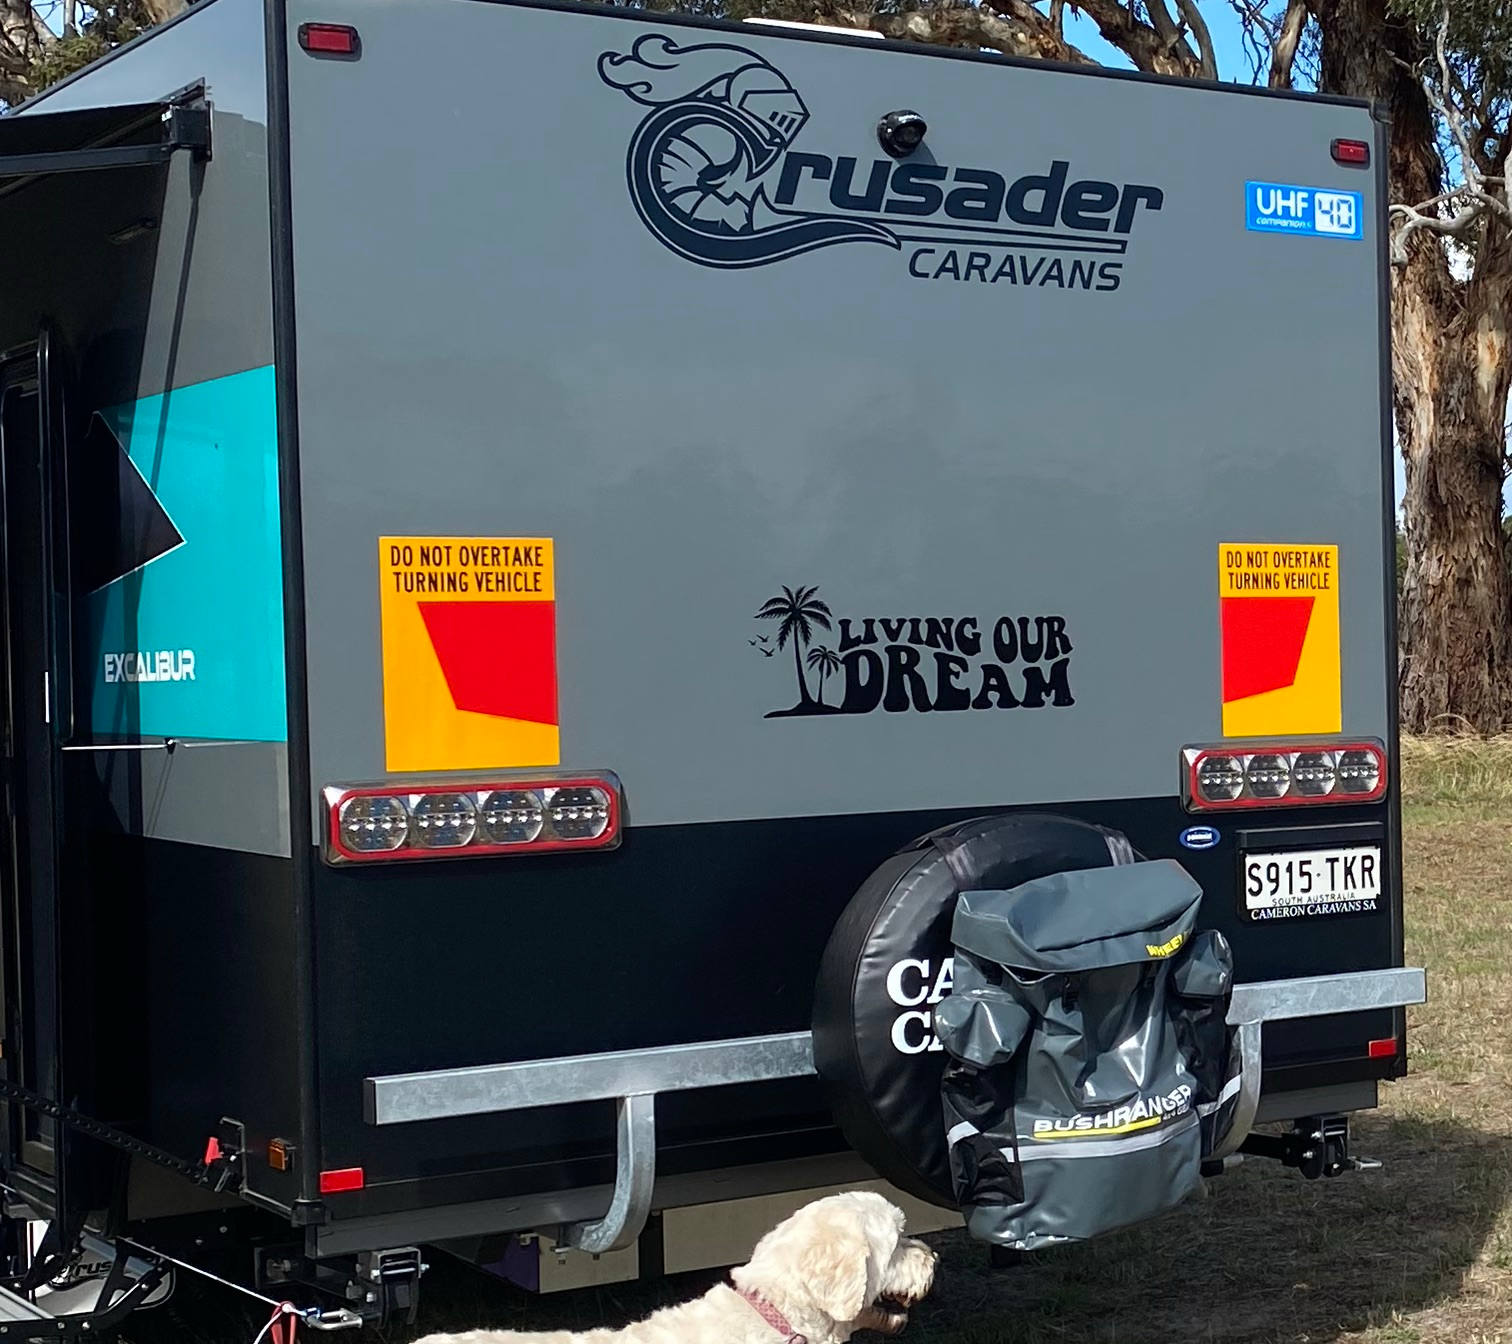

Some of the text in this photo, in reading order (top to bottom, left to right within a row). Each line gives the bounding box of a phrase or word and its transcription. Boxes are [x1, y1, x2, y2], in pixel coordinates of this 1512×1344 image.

[1256, 187, 1352, 229] UHF 40
[909, 248, 1123, 291] CARAVANS
[391, 545, 543, 566] DO NOT OVERTAKE
[1226, 551, 1331, 568] DO NOT OVERTAKE
[393, 572, 542, 592] TURNING VEHICLE
[1228, 572, 1330, 590] TURNING VEHICLE
[838, 616, 1073, 664] LIVING OUR
[104, 649, 195, 682] EXCALIBUR
[840, 645, 1075, 714] DREAM
[1251, 899, 1376, 920] CAMERON CARAVANS SA
[1272, 891, 1356, 907] SOUTH AUSTRALIA
[1034, 1084, 1192, 1132] BUSHRANGER
